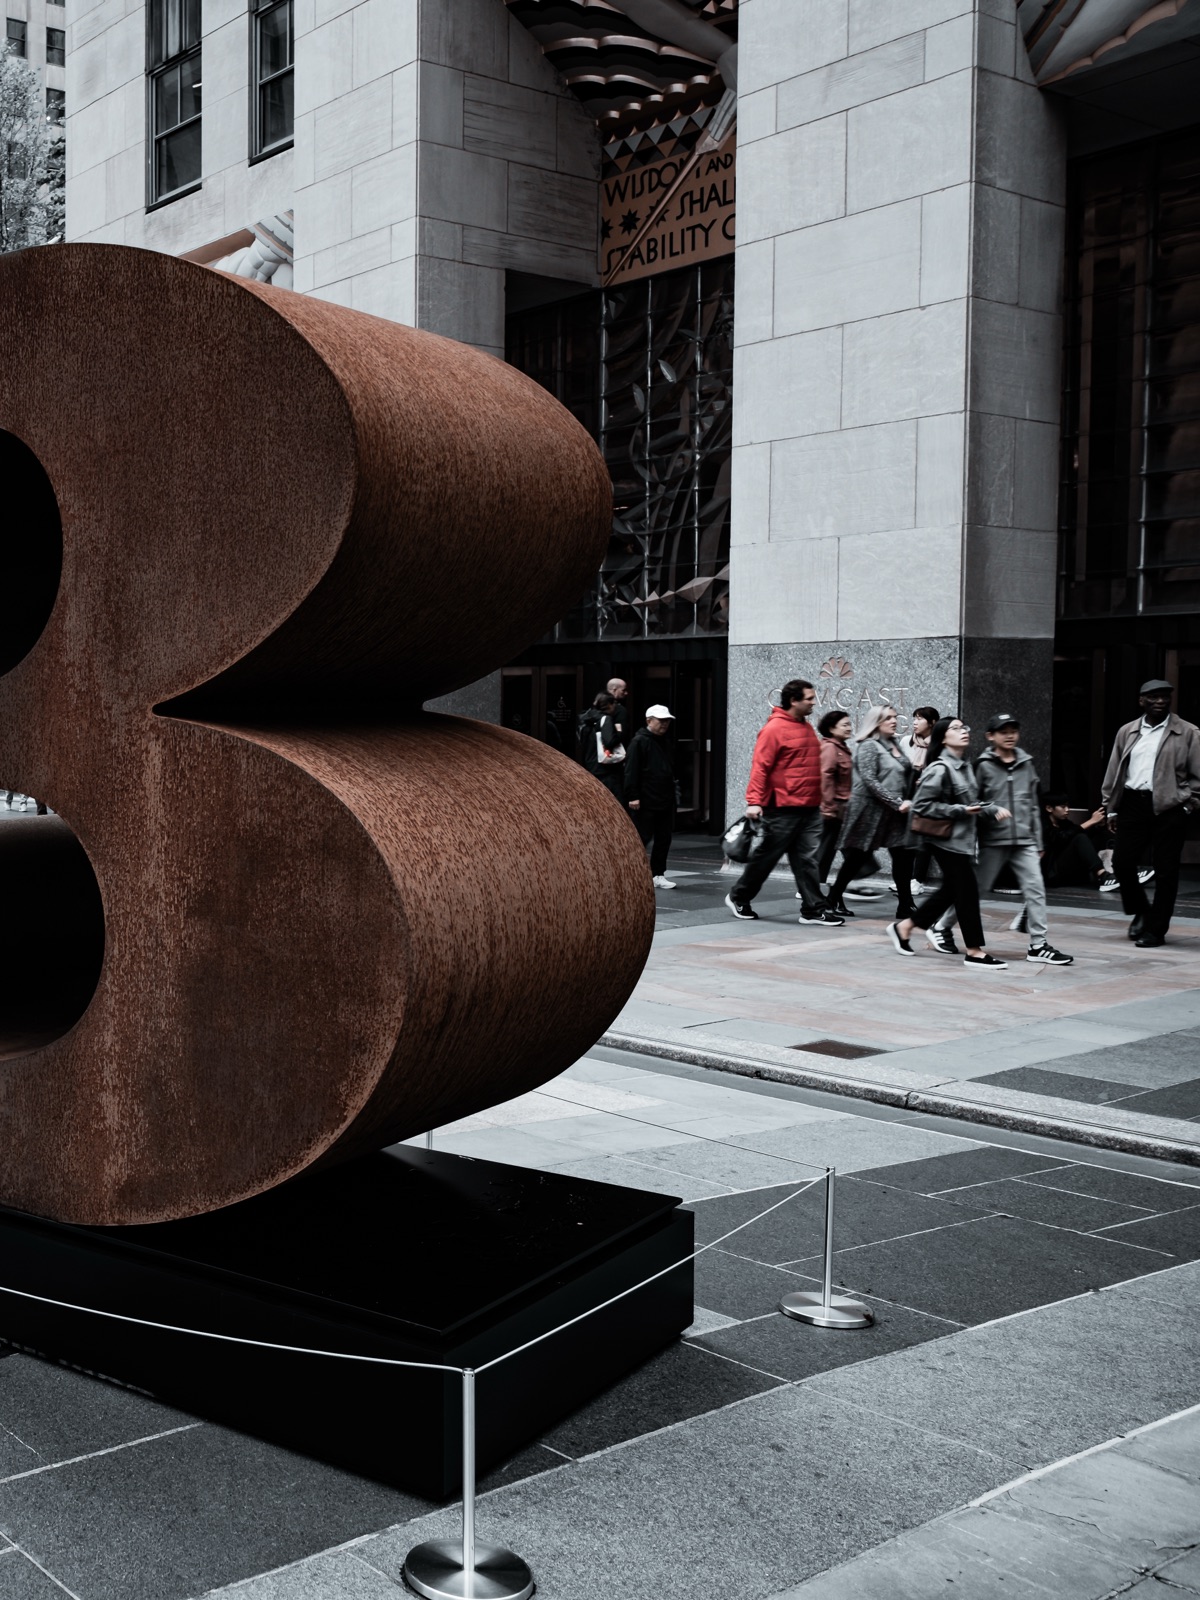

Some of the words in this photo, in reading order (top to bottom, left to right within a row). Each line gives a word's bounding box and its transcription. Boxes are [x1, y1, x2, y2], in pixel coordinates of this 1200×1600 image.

[705, 153, 734, 176] AND
[676, 177, 736, 220] SHAL
[603, 218, 717, 276] STABILITY
[767, 687, 909, 710] CMCAST
